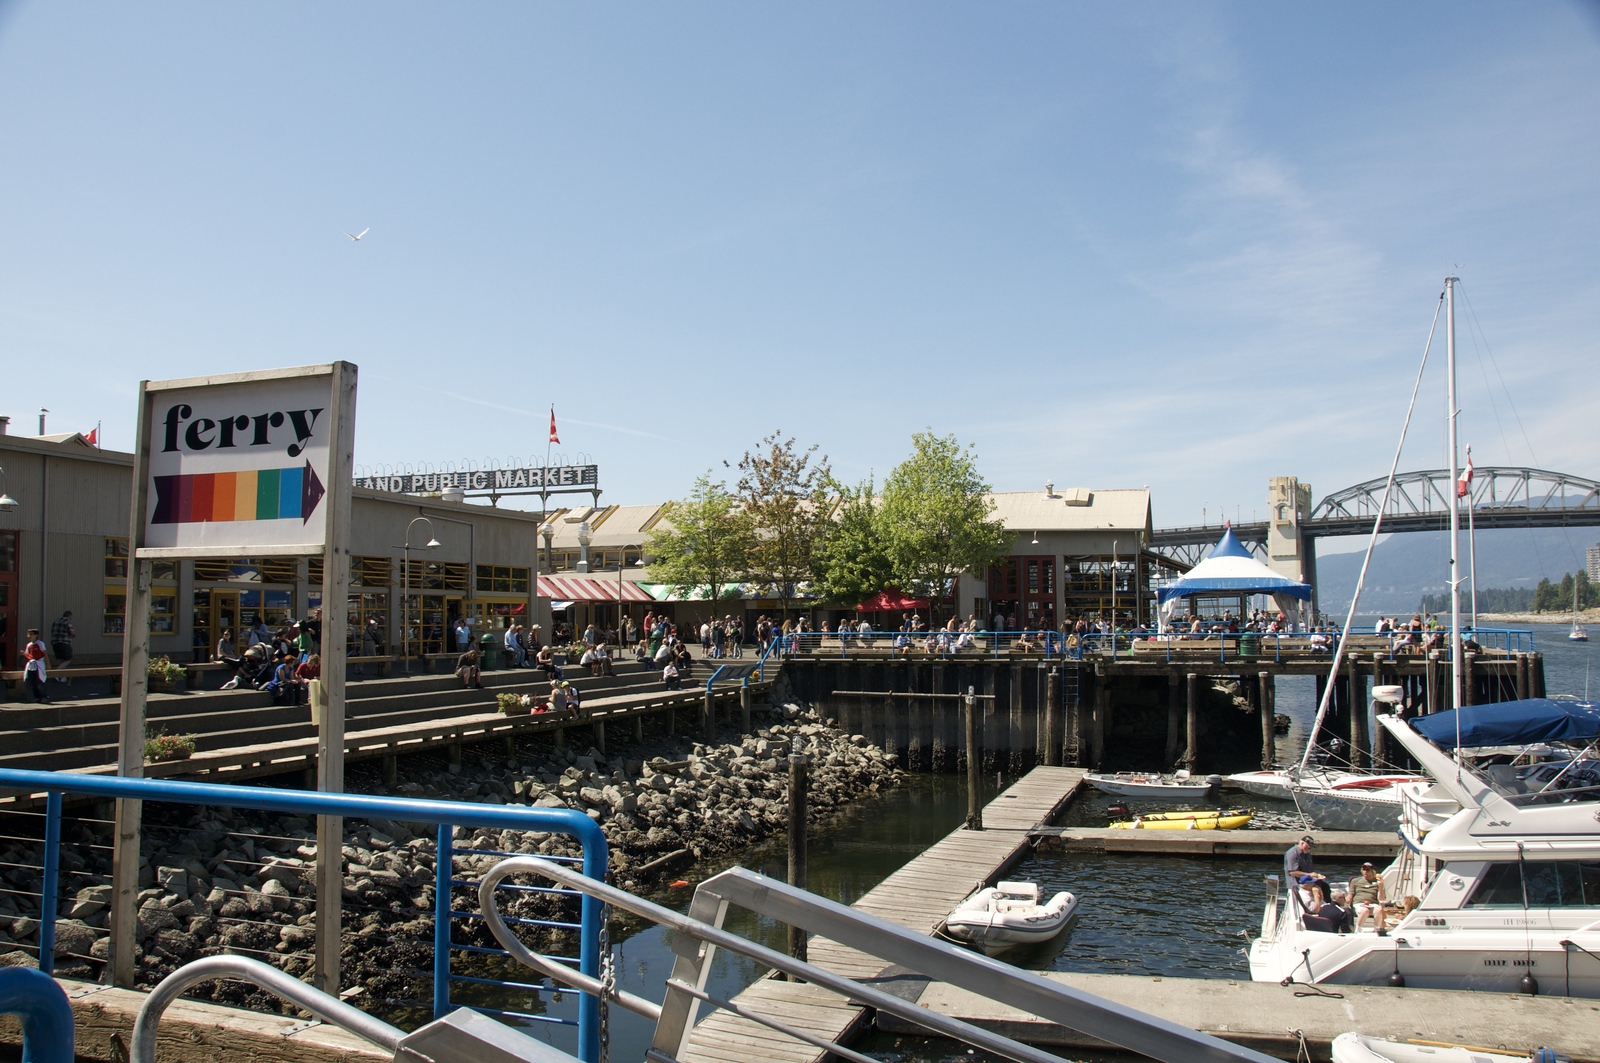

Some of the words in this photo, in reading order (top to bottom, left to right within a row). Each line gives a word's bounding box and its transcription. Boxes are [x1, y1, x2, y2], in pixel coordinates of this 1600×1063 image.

[161, 404, 324, 457] ferry
[412, 471, 487, 492] PUBLIC
[495, 466, 586, 488] MARKET
